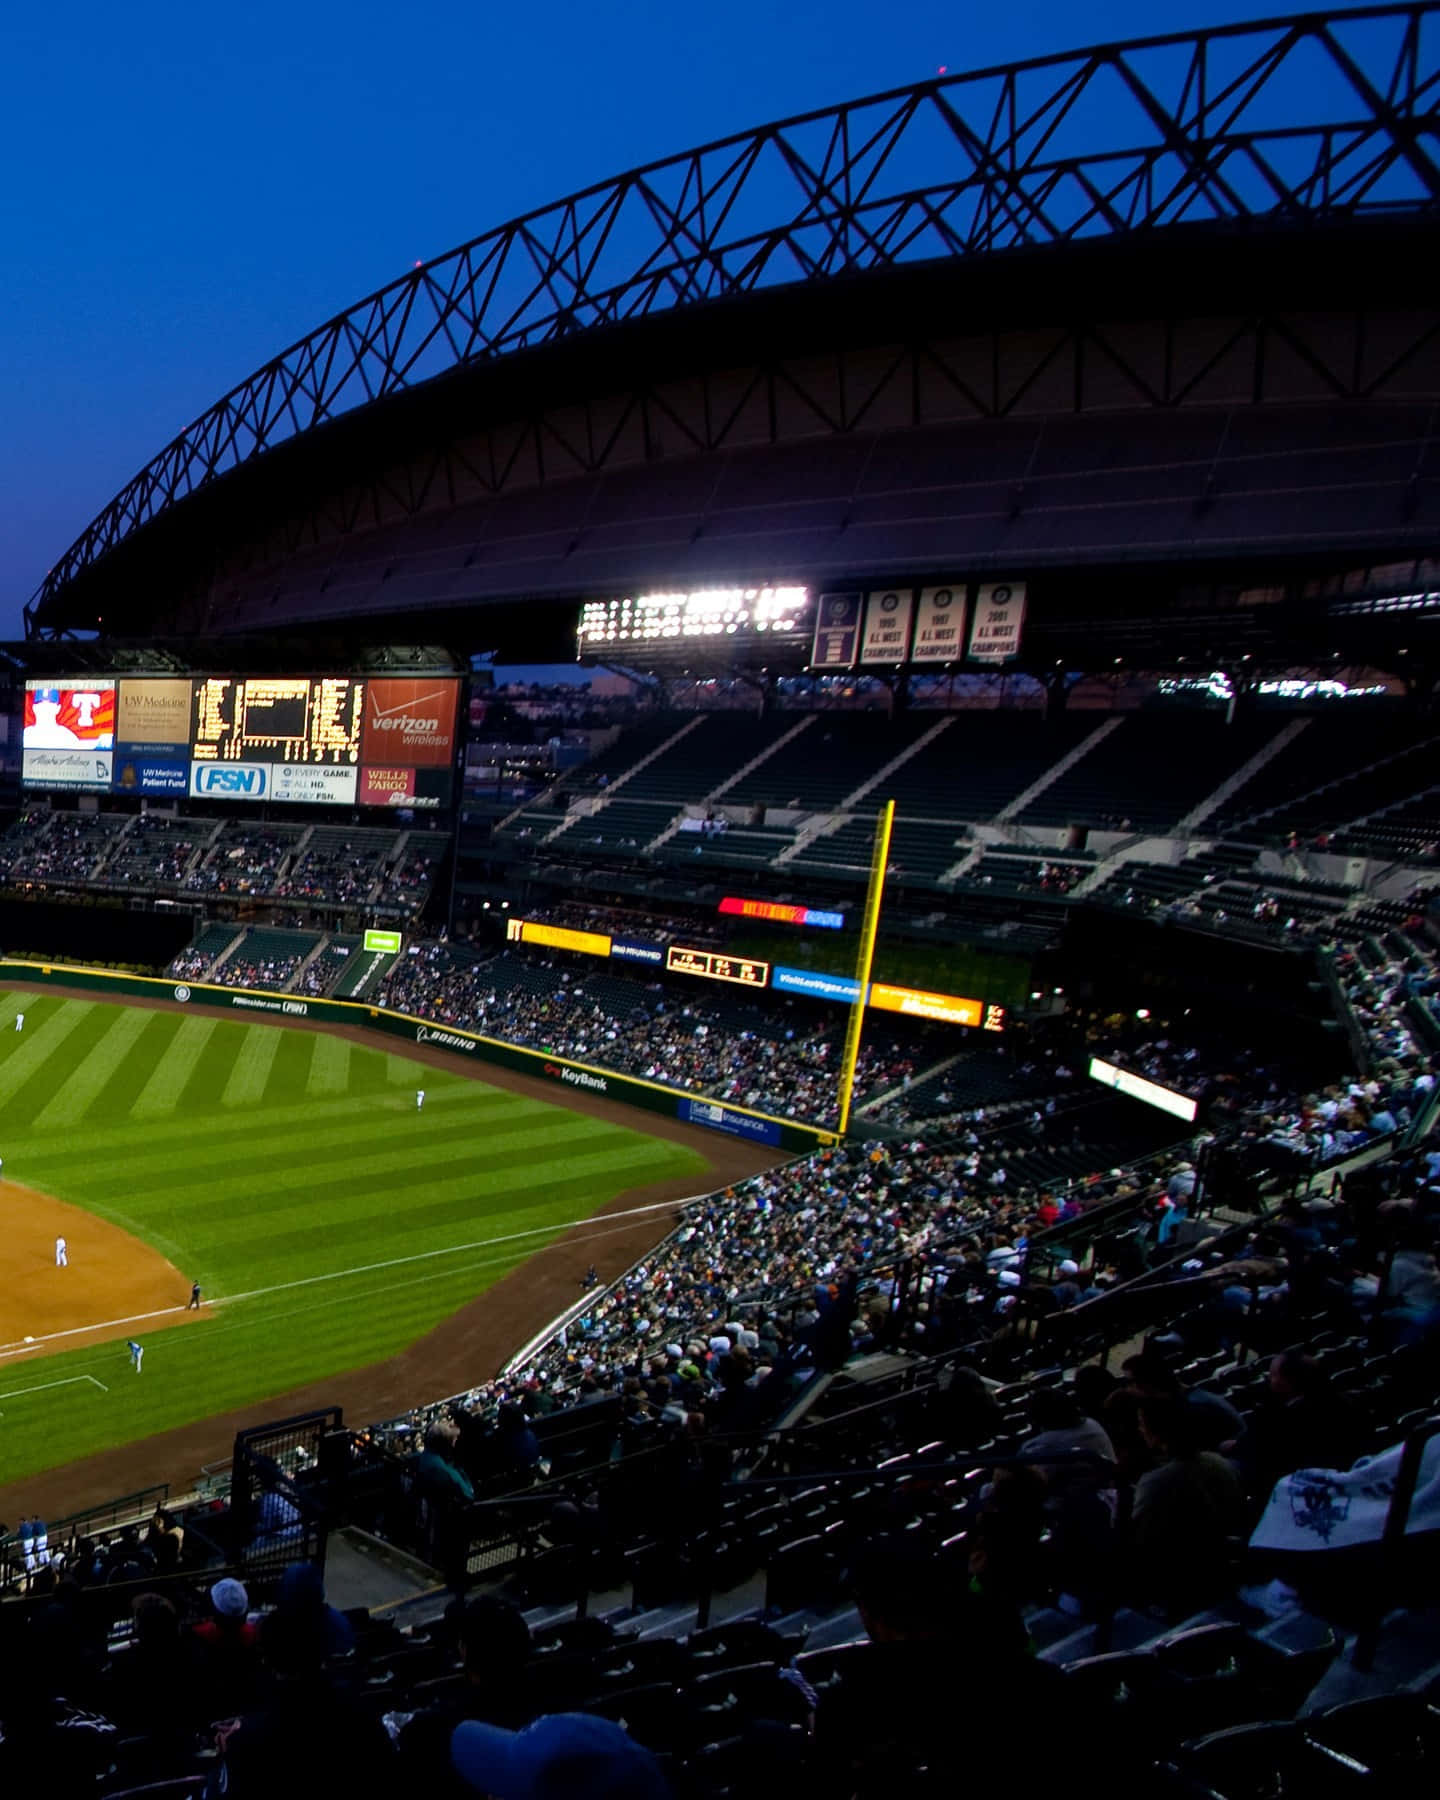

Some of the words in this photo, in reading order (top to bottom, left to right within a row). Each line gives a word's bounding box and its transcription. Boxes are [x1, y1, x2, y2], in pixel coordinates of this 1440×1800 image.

[144, 696, 187, 707] Medicine
[372, 714, 438, 733] verizon
[402, 735, 449, 746] wireless
[206, 769, 255, 792] FSN
[368, 770, 408, 781] WELLS
[142, 779, 169, 788] Patient
[170, 779, 186, 788] Fund
[368, 780, 408, 791] FARGO
[430, 1031, 476, 1050] BOEING
[561, 1067, 607, 1091] KeyBank
[723, 1111, 765, 1132] Insurance
